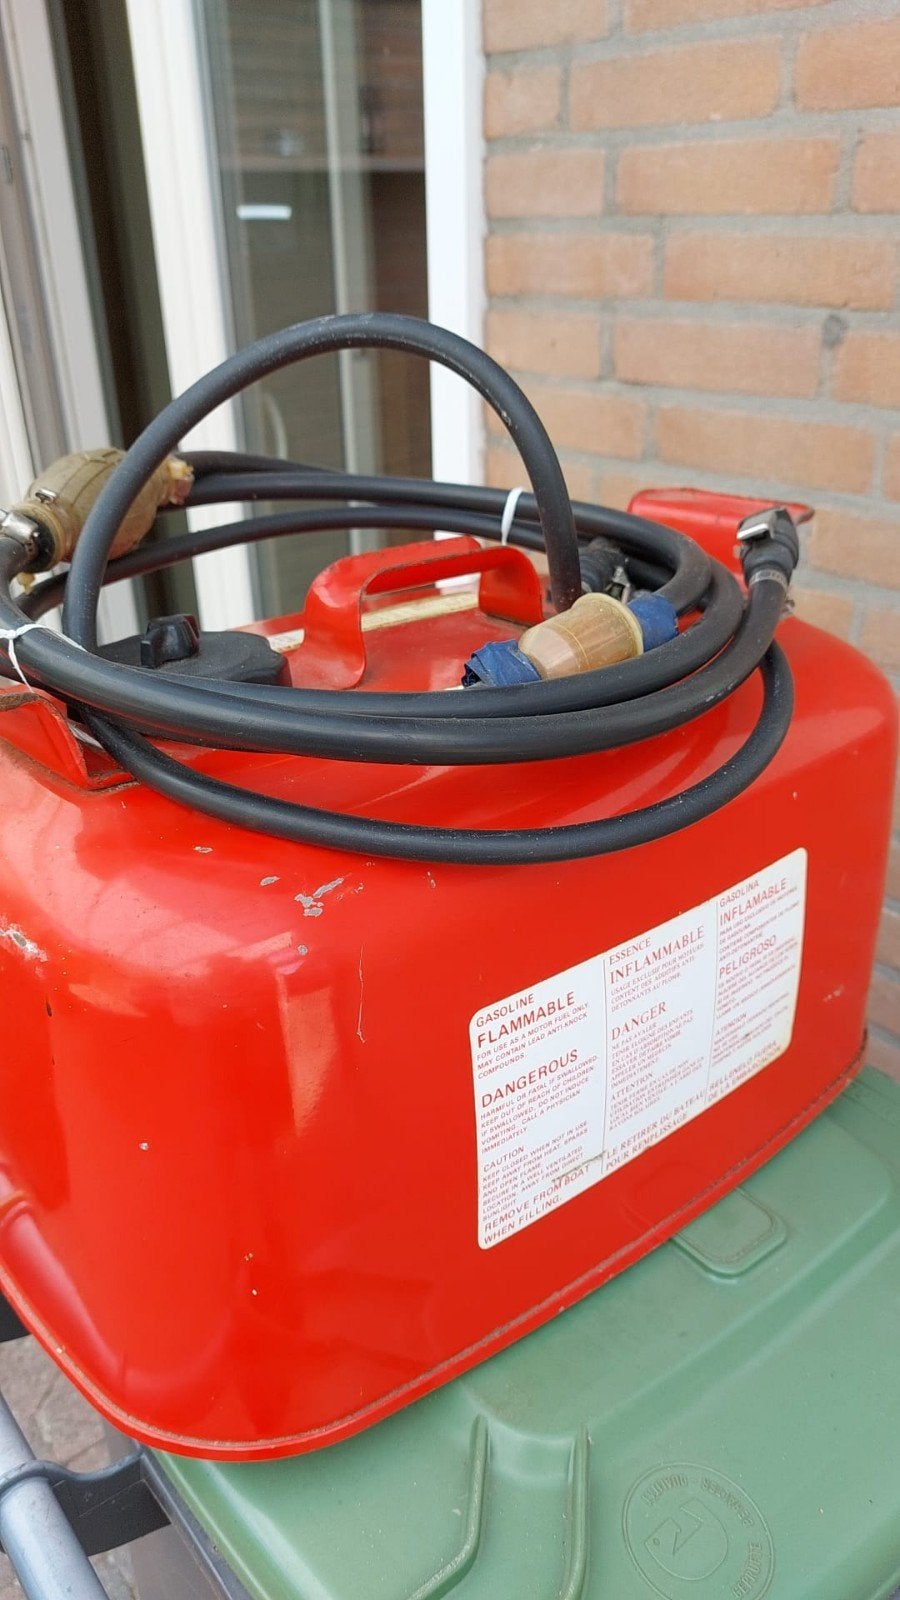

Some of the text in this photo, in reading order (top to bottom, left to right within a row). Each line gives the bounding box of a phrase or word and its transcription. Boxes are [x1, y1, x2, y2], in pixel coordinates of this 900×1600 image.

[719, 878, 759, 908] GASOLINA
[719, 876, 786, 926] INFLAMABLE
[609, 935, 651, 966] ESSENCE
[609, 924, 704, 985] INFLAMMABLE
[719, 933, 776, 979] PELIGROSO
[476, 992, 534, 1029] GASOLINE
[477, 990, 574, 1049] FLAMMABLE
[611, 999, 666, 1041] DANGER
[477, 1049, 490, 1061] FOR
[493, 1041, 506, 1053] USE
[509, 1035, 518, 1045] AS
[528, 1019, 551, 1036] MOTOR
[554, 1010, 569, 1023] FUEL
[477, 1010, 587, 1071] MAY CONTAIN LEAD ANTI-KNOCK
[481, 1047, 577, 1109] DANGEROUS
[538, 1098, 548, 1108] DO
[549, 1090, 562, 1102] NOT
[565, 1075, 588, 1093] INDUCE
[611, 1070, 652, 1101] ATTENTION
[480, 1098, 514, 1121] HARMFUL
[516, 1091, 525, 1102] OR
[528, 1080, 546, 1096] FATAL
[481, 1115, 498, 1129] KEEP
[500, 1106, 514, 1119] OUT
[517, 1101, 525, 1111] OF
[528, 1087, 550, 1105] REACH
[552, 1082, 559, 1092] OF
[521, 1112, 537, 1125] CALL
[546, 1088, 580, 1111] PHYSICIAN
[482, 1169, 499, 1183] KEEP
[502, 1153, 528, 1172] CLOSED
[530, 1140, 549, 1157] WHEN
[551, 1132, 564, 1145] NOT
[567, 1127, 572, 1136] IN
[483, 1176, 499, 1190] KEEP
[502, 1165, 520, 1180] AWAY
[523, 1153, 542, 1168] FROM
[564, 1126, 587, 1145] SPARKS
[483, 1144, 523, 1173] CAUTION
[521, 1177, 538, 1193] AWAY
[541, 1165, 559, 1181] FROM
[561, 1151, 582, 1168] DIRECT
[607, 1145, 618, 1159] LE
[482, 1187, 509, 1206] SECURE
[511, 1182, 518, 1190] IN
[527, 1167, 543, 1181] WELL
[483, 1186, 497, 1199] AND
[500, 1175, 516, 1189] OPEN
[484, 1162, 589, 1233] REMOVE FROM BOAT
[484, 1220, 514, 1245] WHEN
